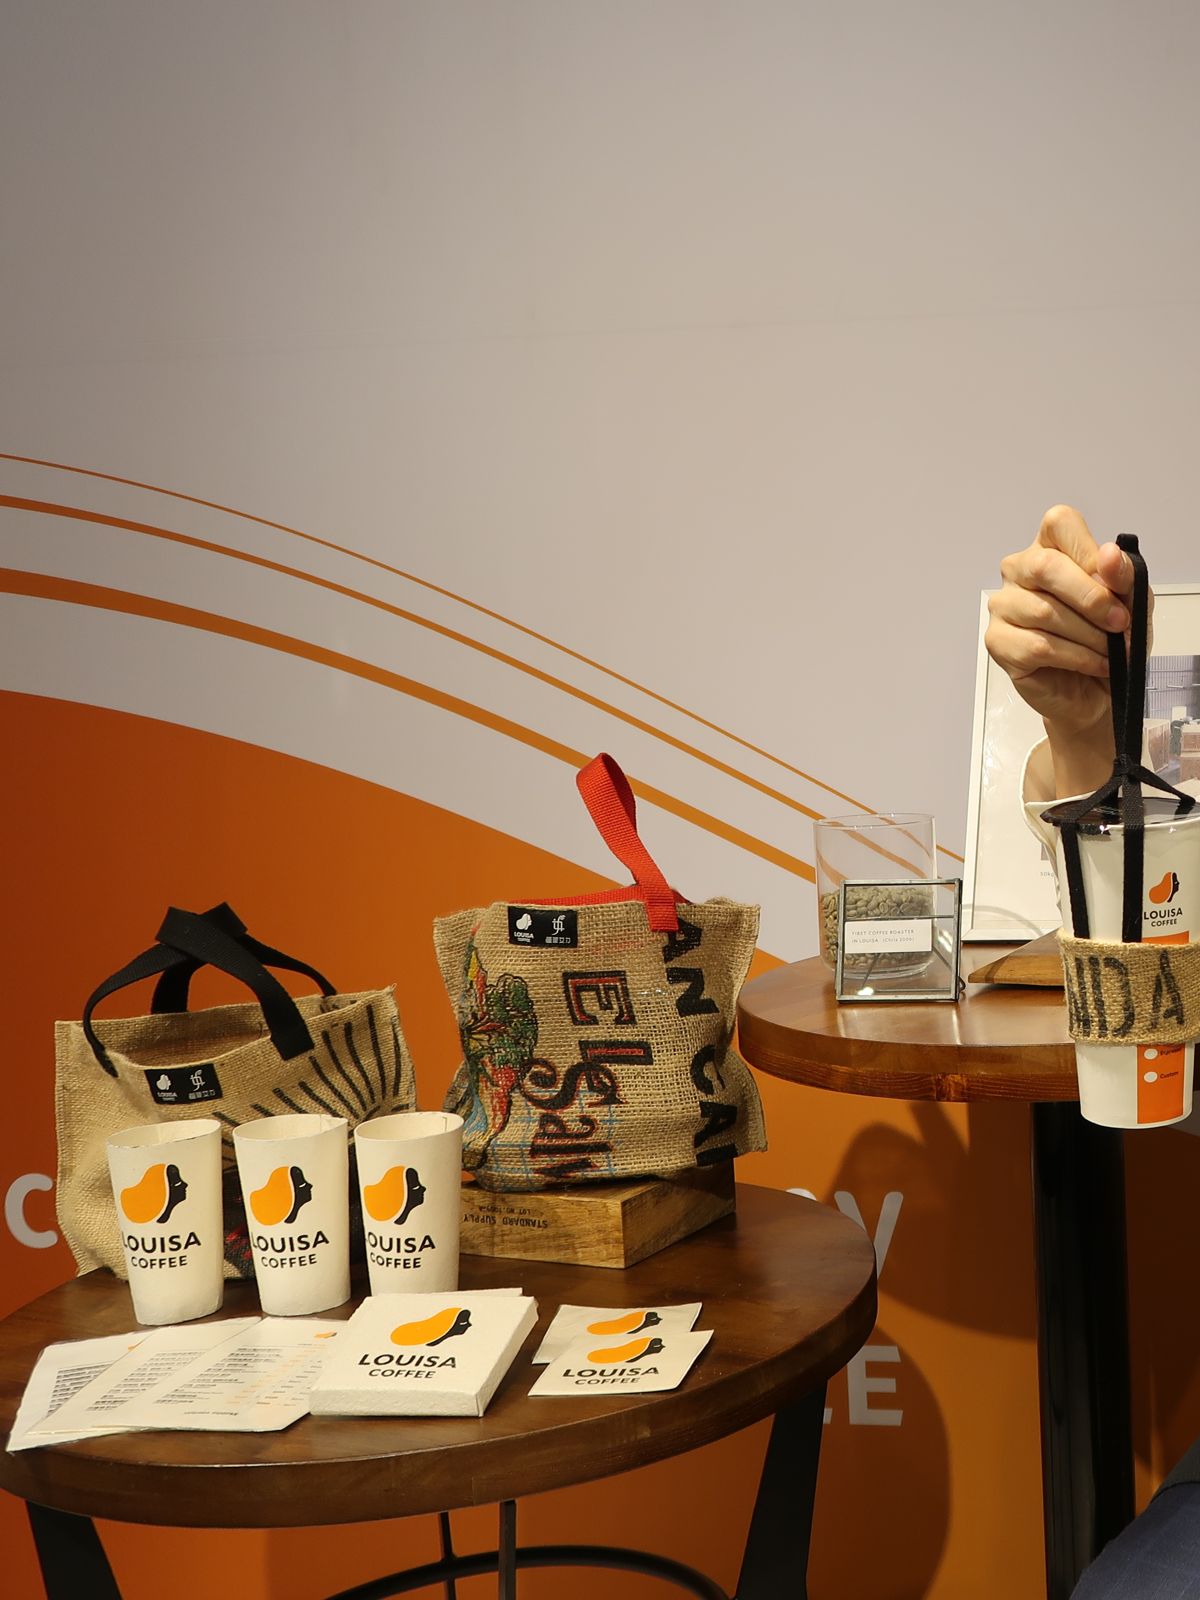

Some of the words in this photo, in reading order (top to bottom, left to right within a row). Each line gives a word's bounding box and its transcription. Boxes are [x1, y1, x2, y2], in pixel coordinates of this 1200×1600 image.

[1143, 908, 1183, 920] LOUISA
[1151, 919, 1178, 927] COFFEE
[464, 1214, 497, 1225] SUPPLY
[503, 1216, 548, 1229] STANDARD
[367, 1231, 436, 1254] OUISA
[131, 1255, 188, 1269] COFFEE
[261, 1253, 317, 1268] COFFEE
[370, 1252, 422, 1269] COFFEE
[358, 1353, 456, 1368] LOUISA
[368, 1368, 436, 1378] COFFEE
[562, 1367, 660, 1378] LOUISA
[574, 1377, 641, 1386] COFFEE
